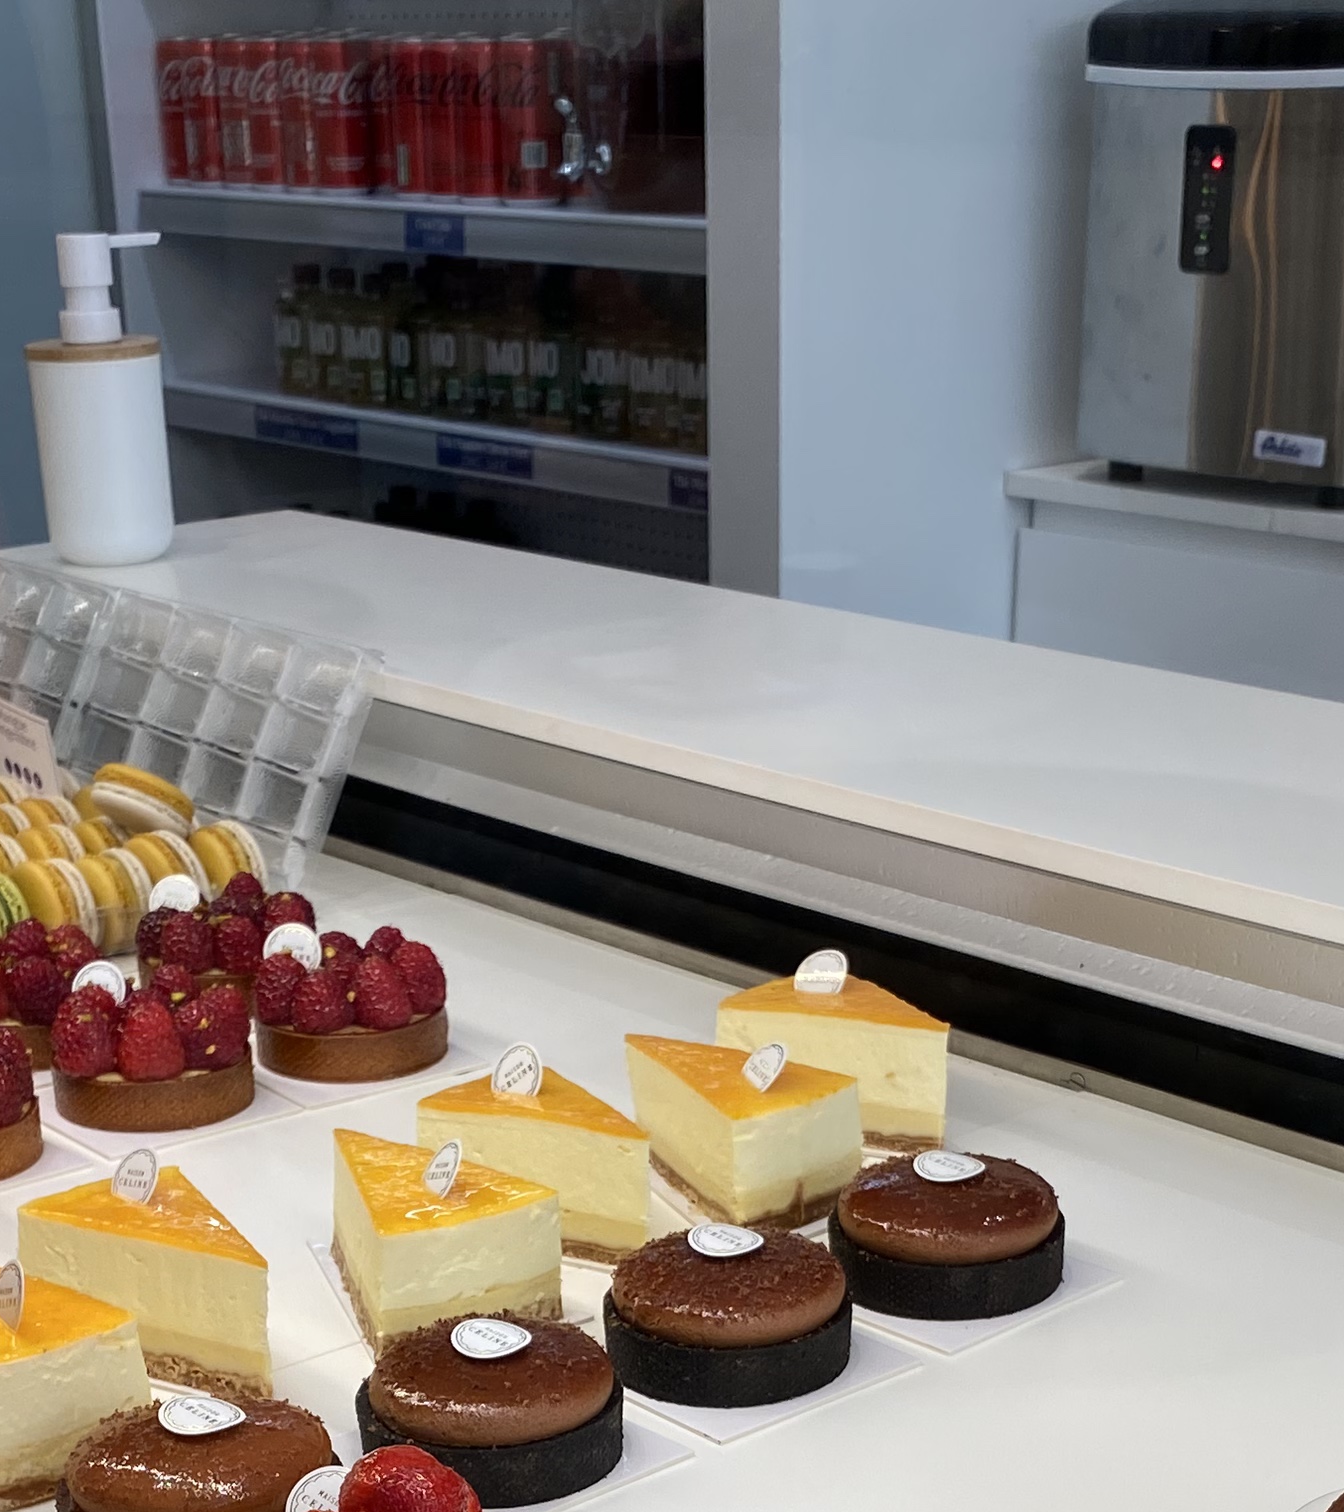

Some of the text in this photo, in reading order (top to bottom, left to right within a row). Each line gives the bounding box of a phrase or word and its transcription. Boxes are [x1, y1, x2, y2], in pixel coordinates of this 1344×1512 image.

[118, 1178, 147, 1189] CELINE
[468, 1325, 509, 1346] CELINE
[179, 1401, 218, 1424] CELINE
